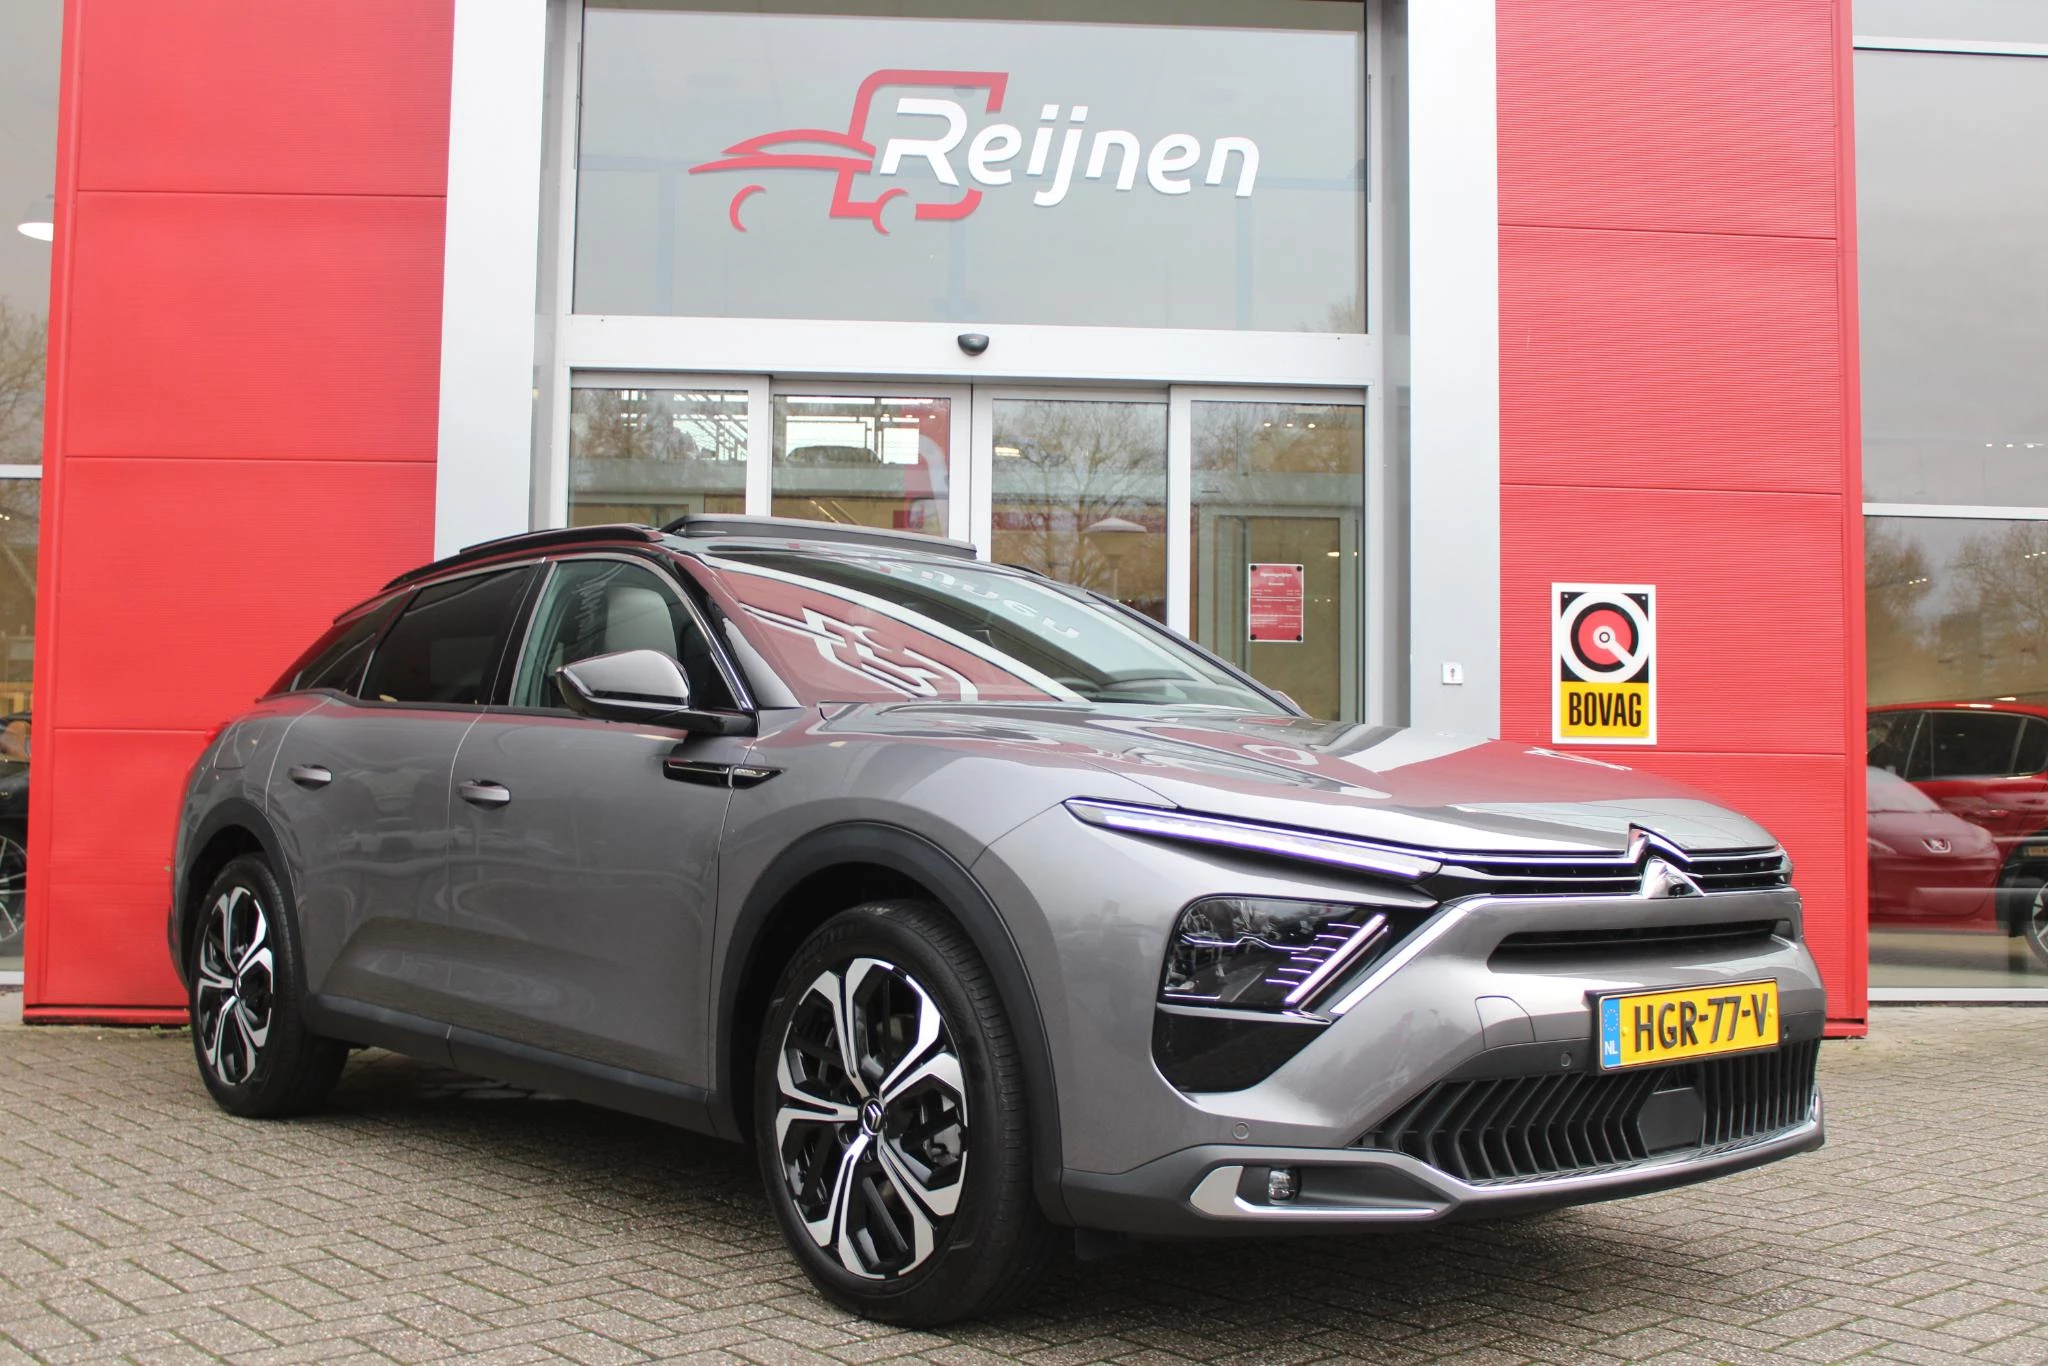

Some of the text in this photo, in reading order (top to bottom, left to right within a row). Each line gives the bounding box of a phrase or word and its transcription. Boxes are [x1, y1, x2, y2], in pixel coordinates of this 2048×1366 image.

[880, 97, 1260, 207] Reijnen
[1568, 691, 1642, 727] BOVAG
[1604, 1039, 1619, 1055] NL
[1634, 993, 1769, 1053] HGR-77-V
